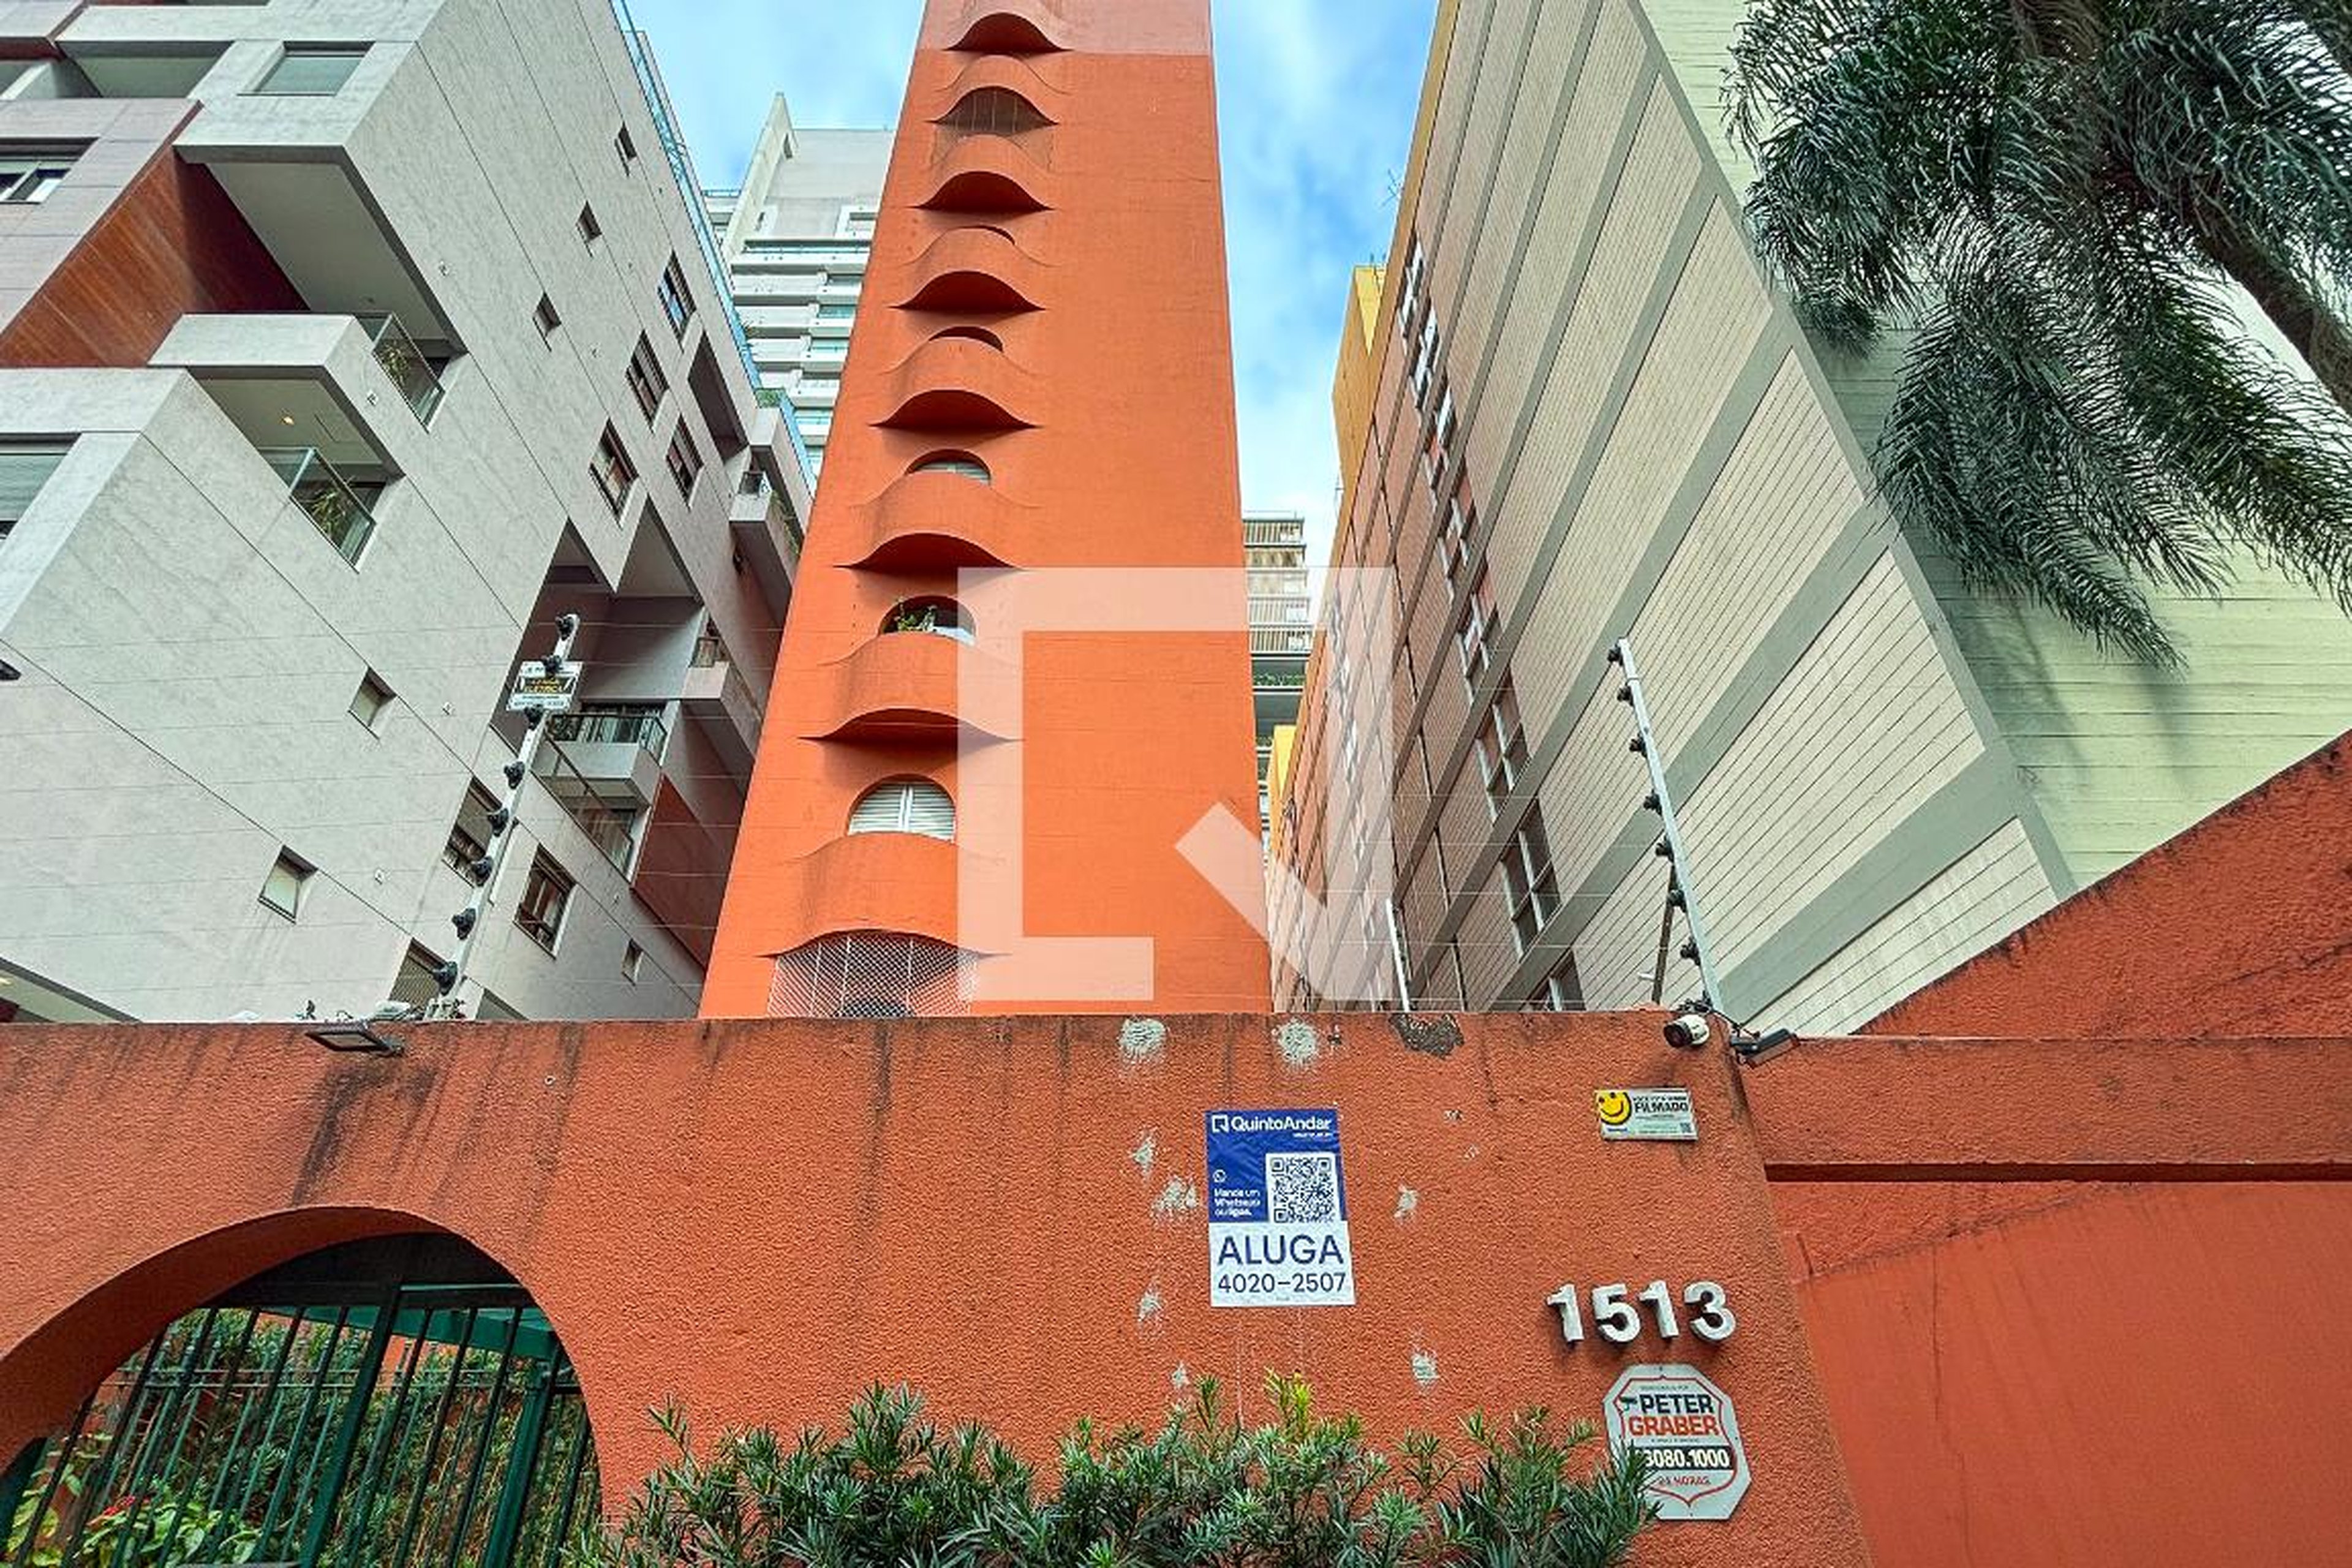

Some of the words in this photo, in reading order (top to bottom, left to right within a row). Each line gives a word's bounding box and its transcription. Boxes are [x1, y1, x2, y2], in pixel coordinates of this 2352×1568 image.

[1635, 1102, 1689, 1113] FILMADO
[1231, 1115, 1332, 1132] QuintoAndar
[1217, 1234, 1344, 1265] ALUGA
[1218, 1272, 1346, 1293] 4020-2507
[1547, 1280, 1737, 1344] 1513
[1639, 1393, 1714, 1414] PETER
[1628, 1415, 1720, 1436] GRABER
